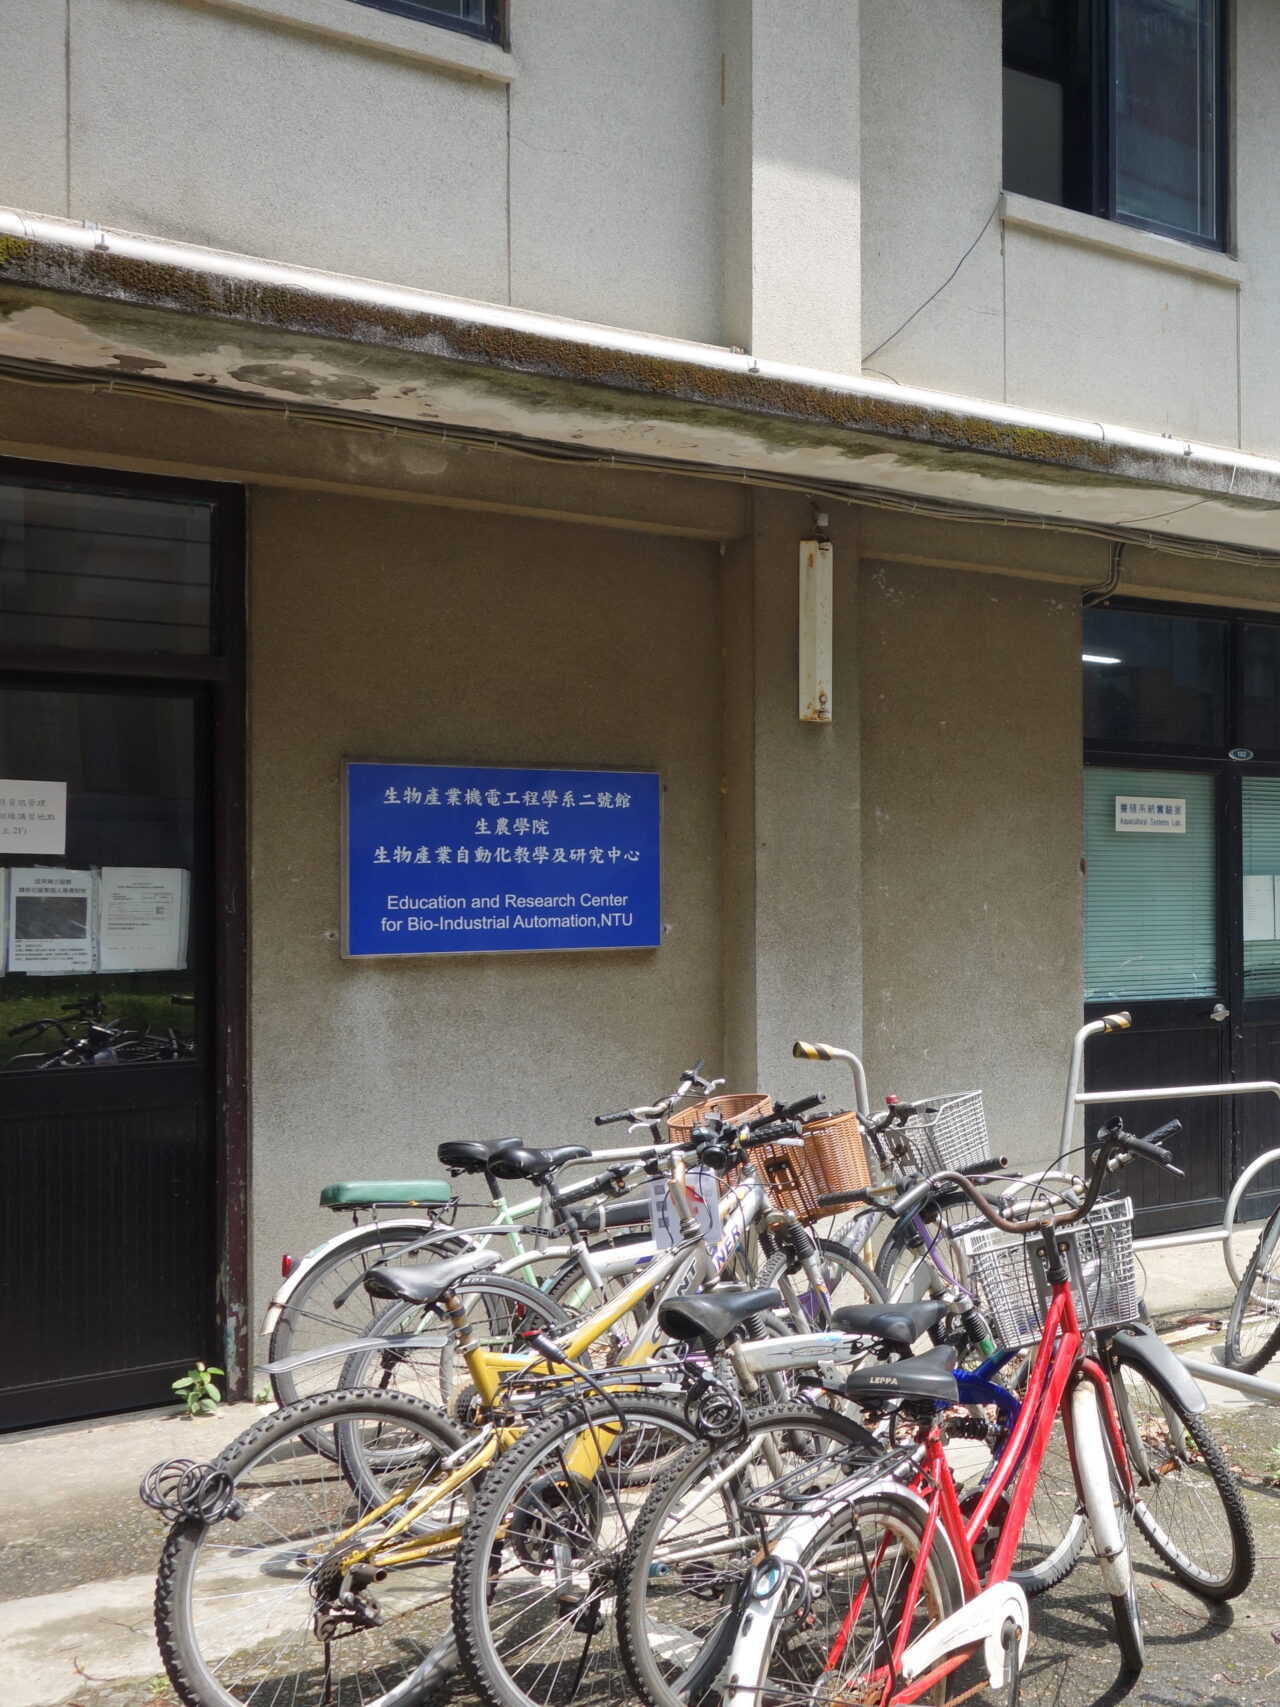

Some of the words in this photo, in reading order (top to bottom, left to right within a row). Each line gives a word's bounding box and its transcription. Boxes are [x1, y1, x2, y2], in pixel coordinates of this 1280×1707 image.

[383, 787, 632, 809] 生物產業機電工程學系二號館
[474, 817, 550, 837] 生農學院
[373, 845, 640, 865] 生物產業自動化教學及研究中心
[387, 894, 466, 910] Education
[471, 893, 500, 908] and
[505, 893, 576, 908] Research
[580, 893, 628, 907] Center
[381, 916, 403, 932] for
[408, 914, 510, 931] Bio-Industrial
[513, 912, 633, 930] Automation,NTU
[870, 1376, 898, 1385] LEPPA
